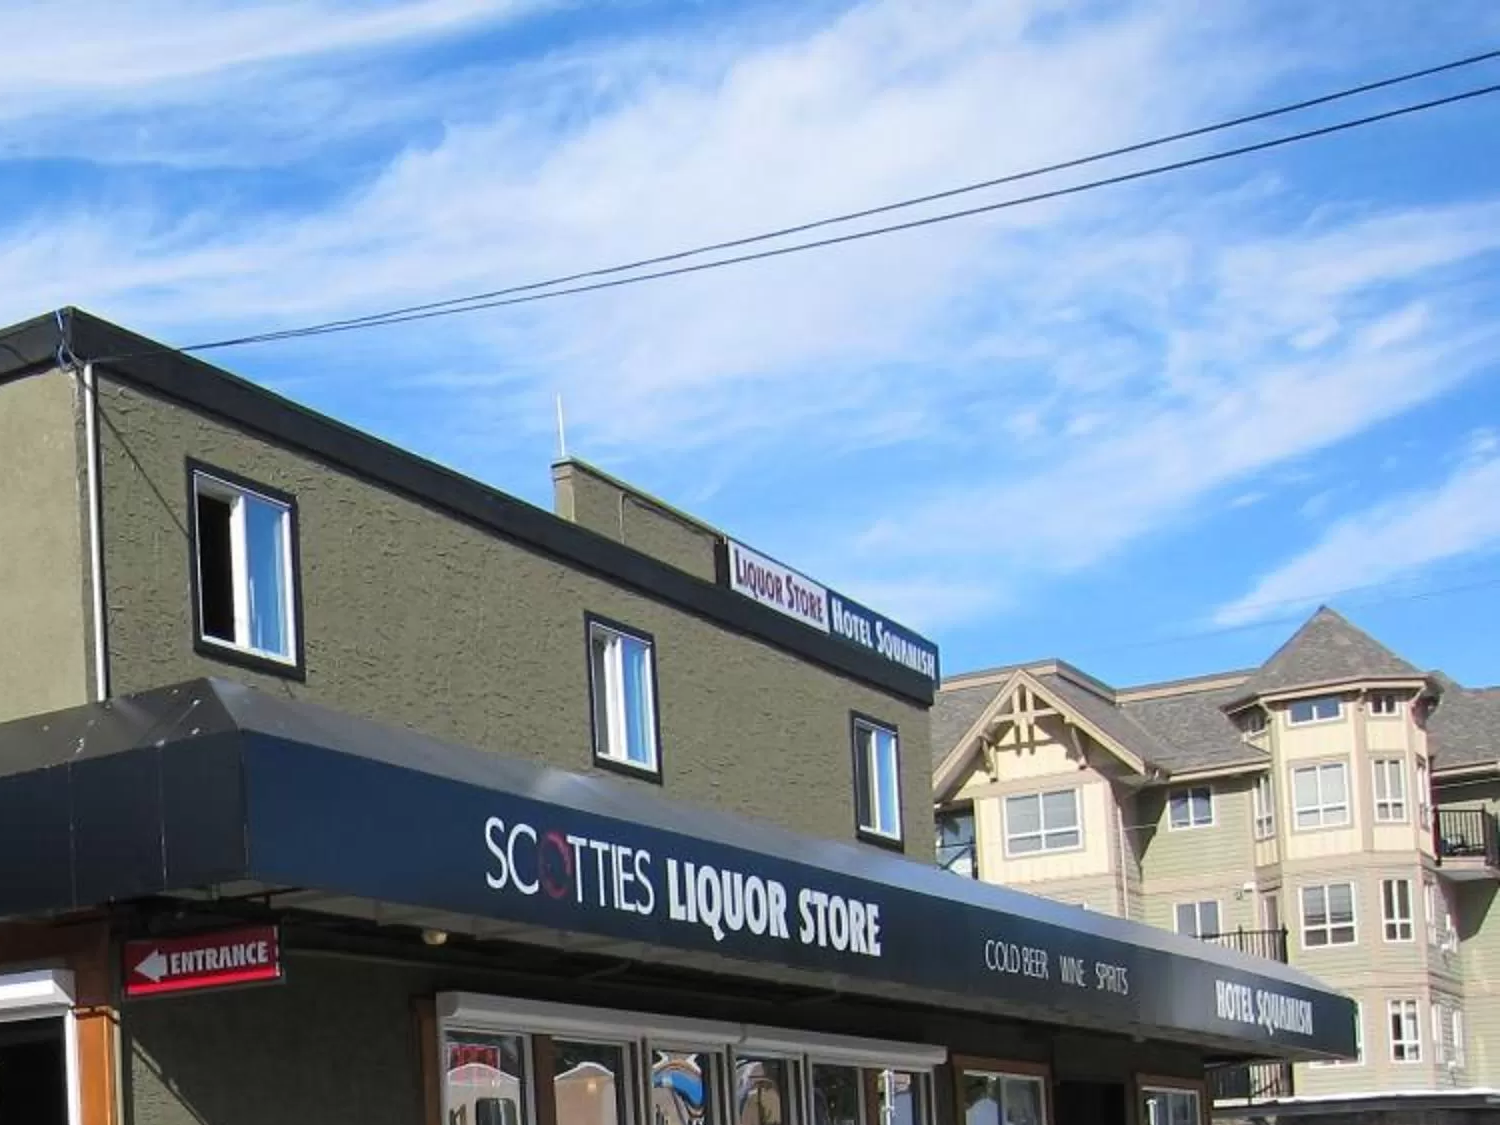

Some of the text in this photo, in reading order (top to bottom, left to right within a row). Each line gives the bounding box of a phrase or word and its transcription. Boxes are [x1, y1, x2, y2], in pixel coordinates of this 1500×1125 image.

[733, 547, 823, 623] LIQUOR STORE
[831, 597, 873, 649] HOTEL
[484, 816, 881, 957] SCOTTIES LIQUOR STORE
[170, 941, 269, 975] ENTRANCE
[985, 939, 1020, 974] COLD
[1021, 946, 1049, 981] BEER
[1059, 954, 1088, 988] WINE
[1215, 979, 1255, 1024] HOTEL
